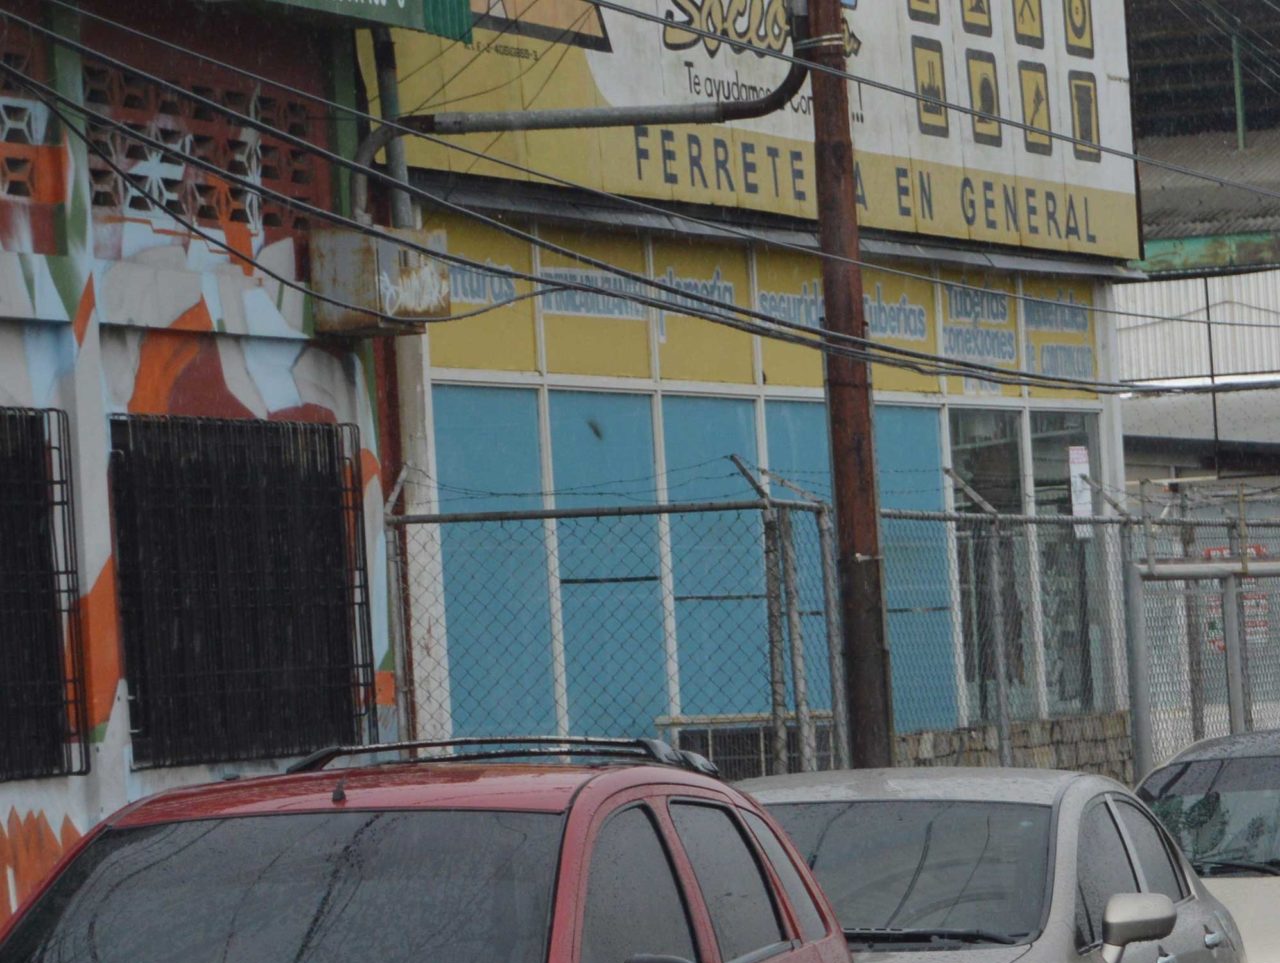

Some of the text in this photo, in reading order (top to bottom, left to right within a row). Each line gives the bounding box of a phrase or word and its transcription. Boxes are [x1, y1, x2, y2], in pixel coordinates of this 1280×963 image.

[684, 61, 701, 94] Te
[633, 124, 1097, 243] FERRETEA EN GENERAL
